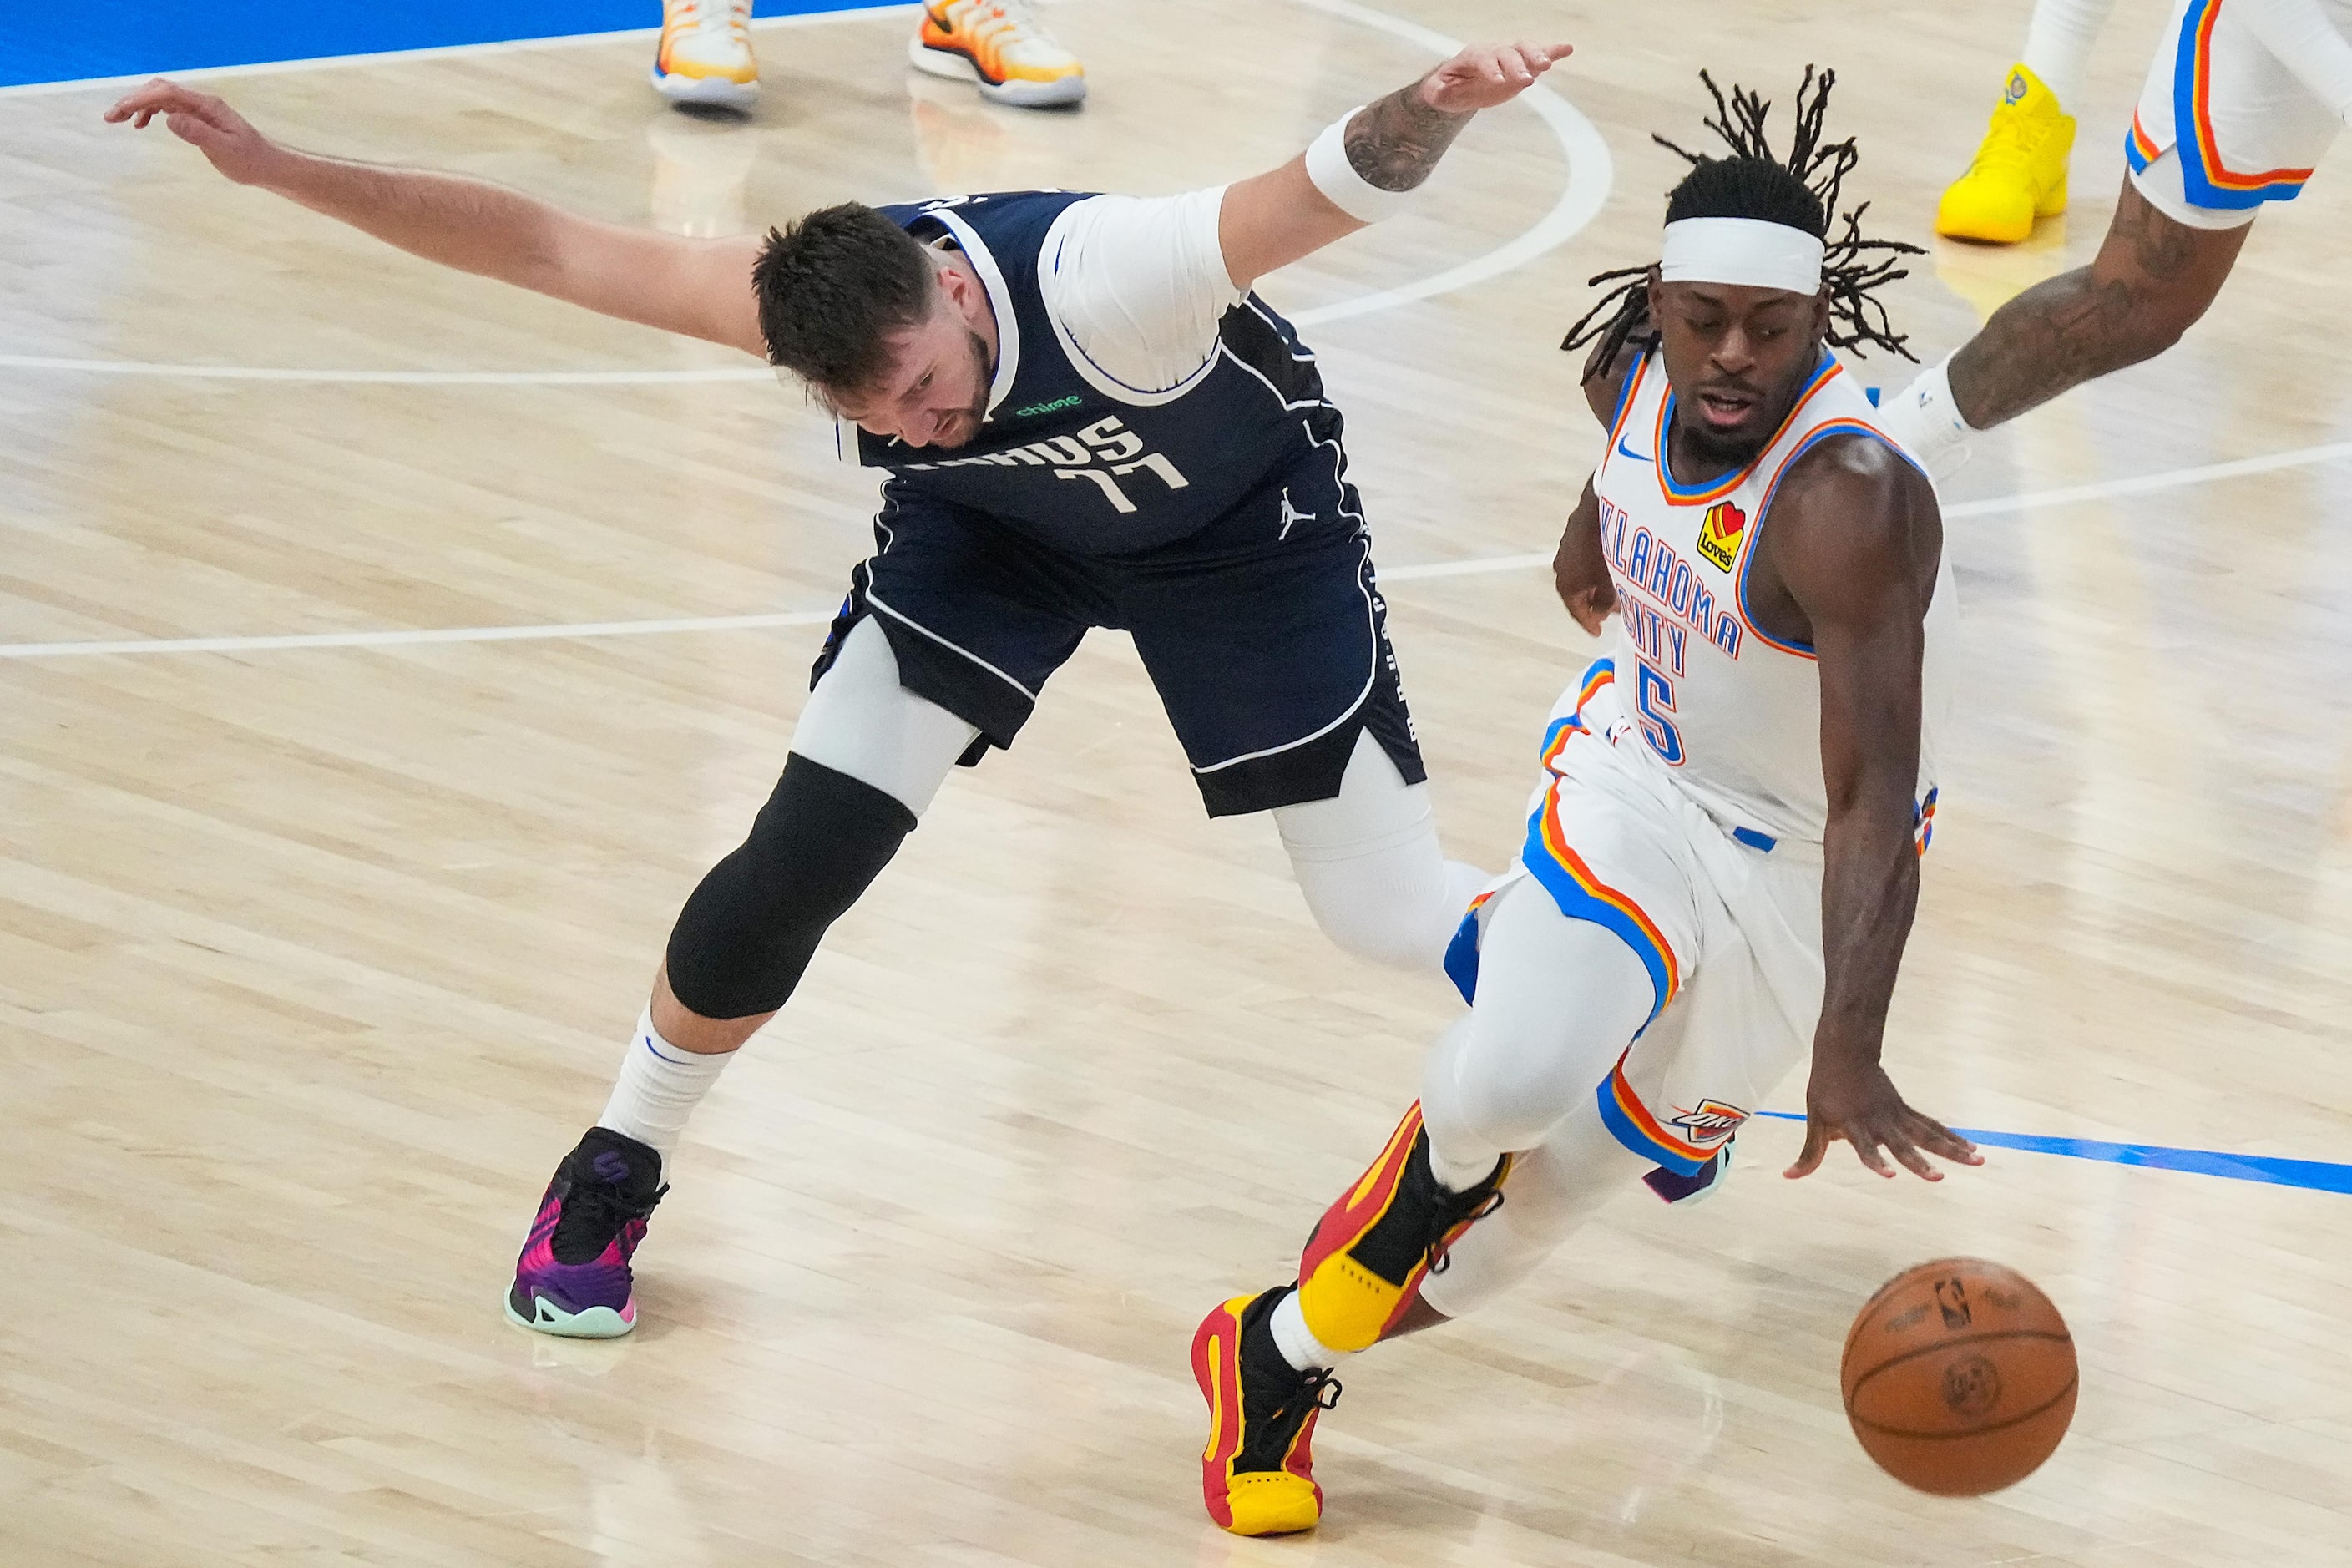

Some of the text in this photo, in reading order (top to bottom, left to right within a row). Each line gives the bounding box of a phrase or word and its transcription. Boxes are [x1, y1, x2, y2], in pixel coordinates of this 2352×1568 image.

[1015, 395, 1083, 416] chime
[1053, 452, 1190, 513] 77
[1601, 496, 1743, 660] KLAHOMA
[1616, 583, 1687, 678] CITY
[1635, 653, 1687, 767] 5
